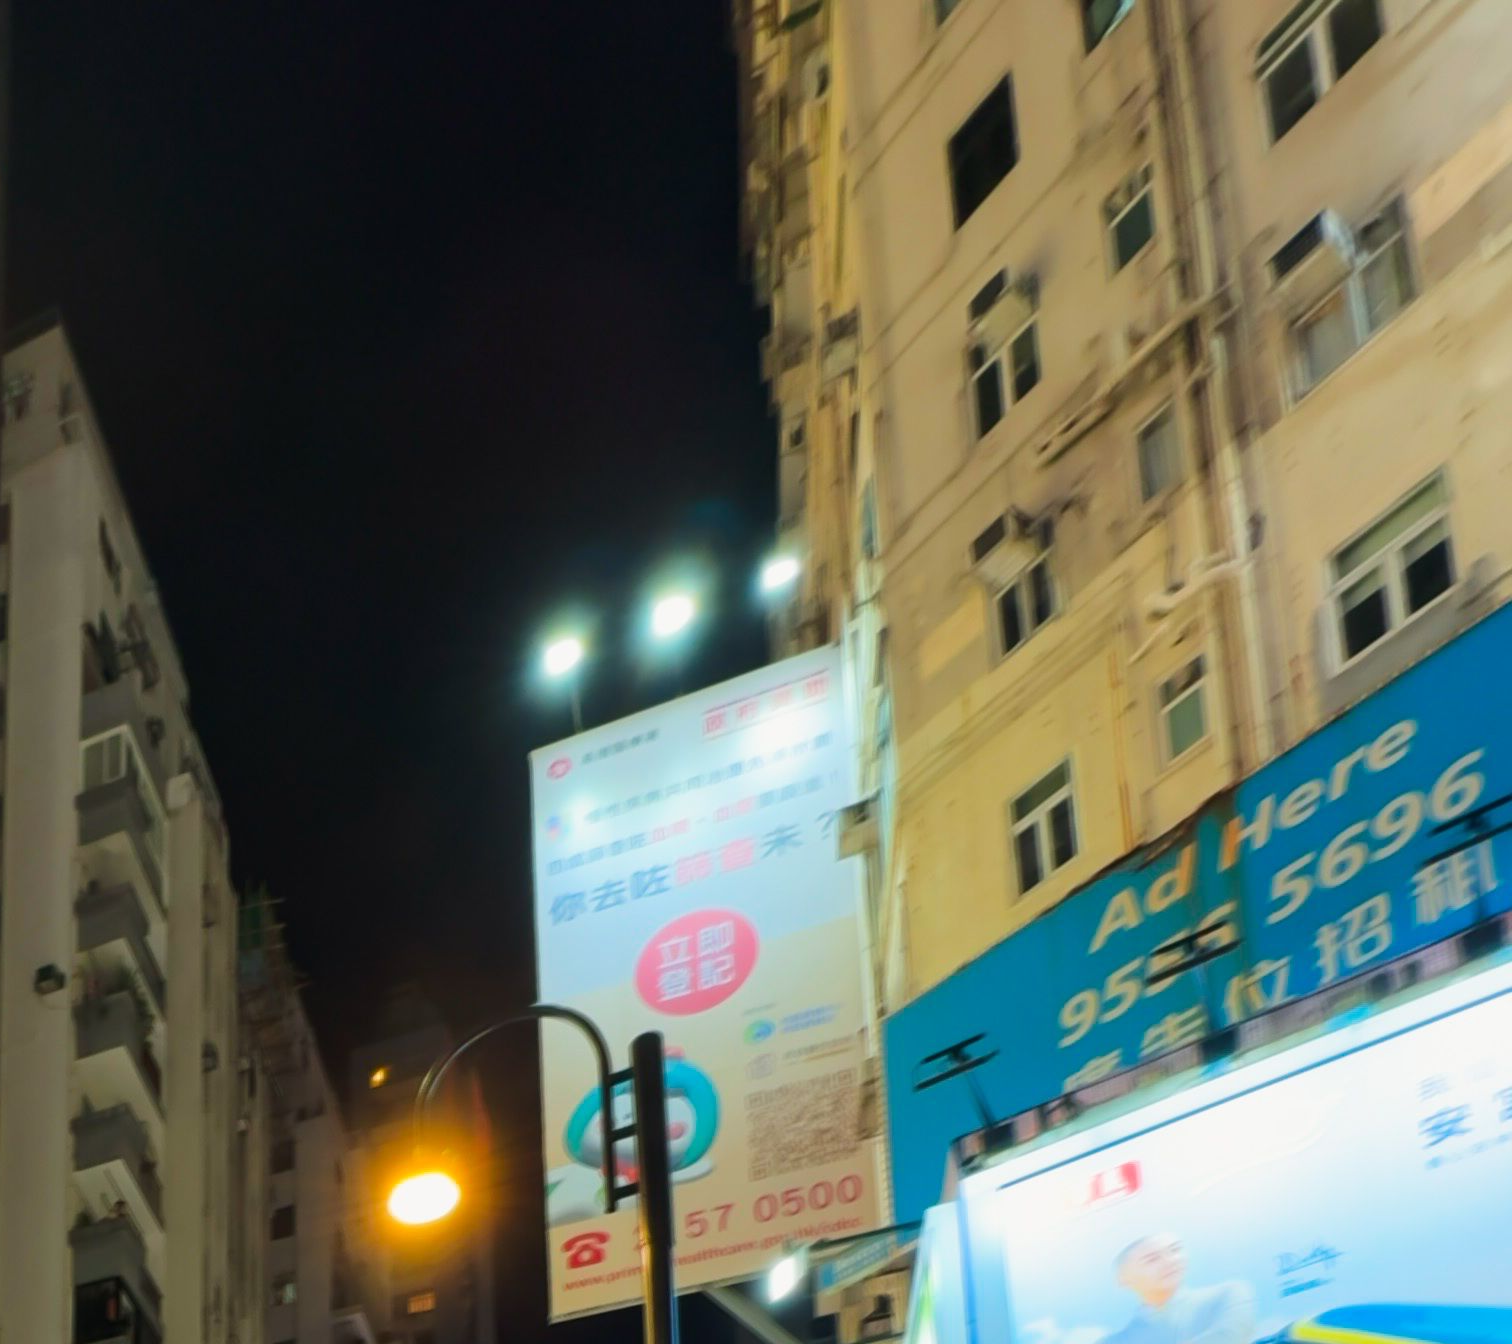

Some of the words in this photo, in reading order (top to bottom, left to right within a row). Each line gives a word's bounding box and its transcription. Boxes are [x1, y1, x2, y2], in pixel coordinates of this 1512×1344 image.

[1089, 841, 1196, 953] Ad
[1218, 718, 1419, 870] Here
[1267, 749, 1485, 925] 5696
[752, 1173, 864, 1225] 0500
